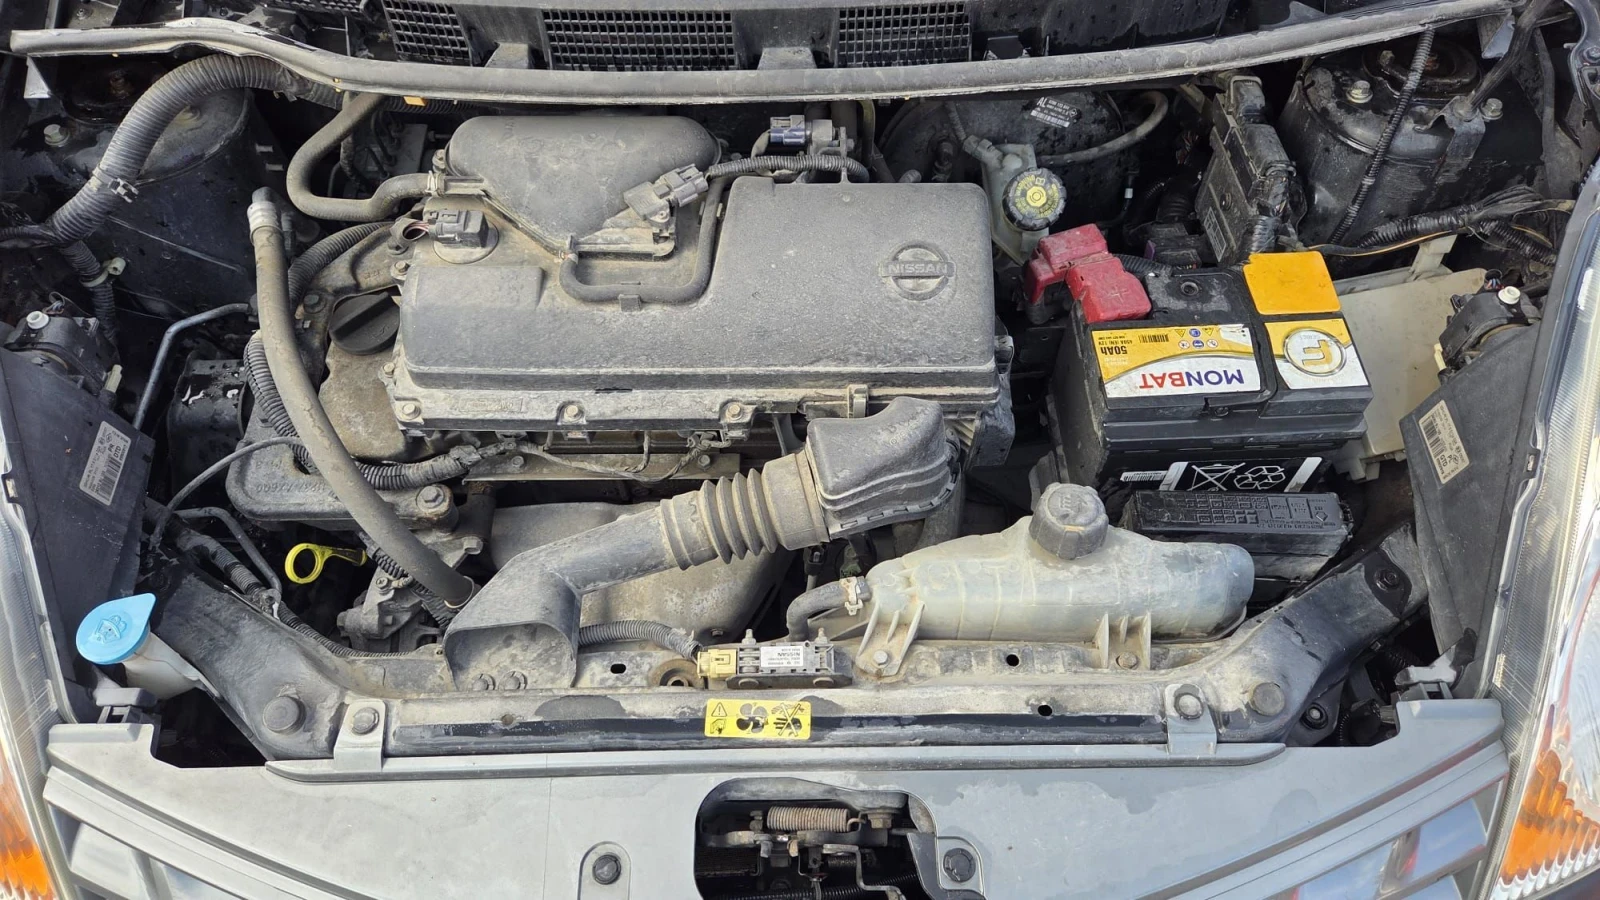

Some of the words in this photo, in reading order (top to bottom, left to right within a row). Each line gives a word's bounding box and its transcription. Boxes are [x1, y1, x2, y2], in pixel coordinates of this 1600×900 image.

[888, 263, 948, 274] NISSAN
[1100, 345, 1127, 355] 50Ah
[1138, 370, 1245, 389] MONBAT
